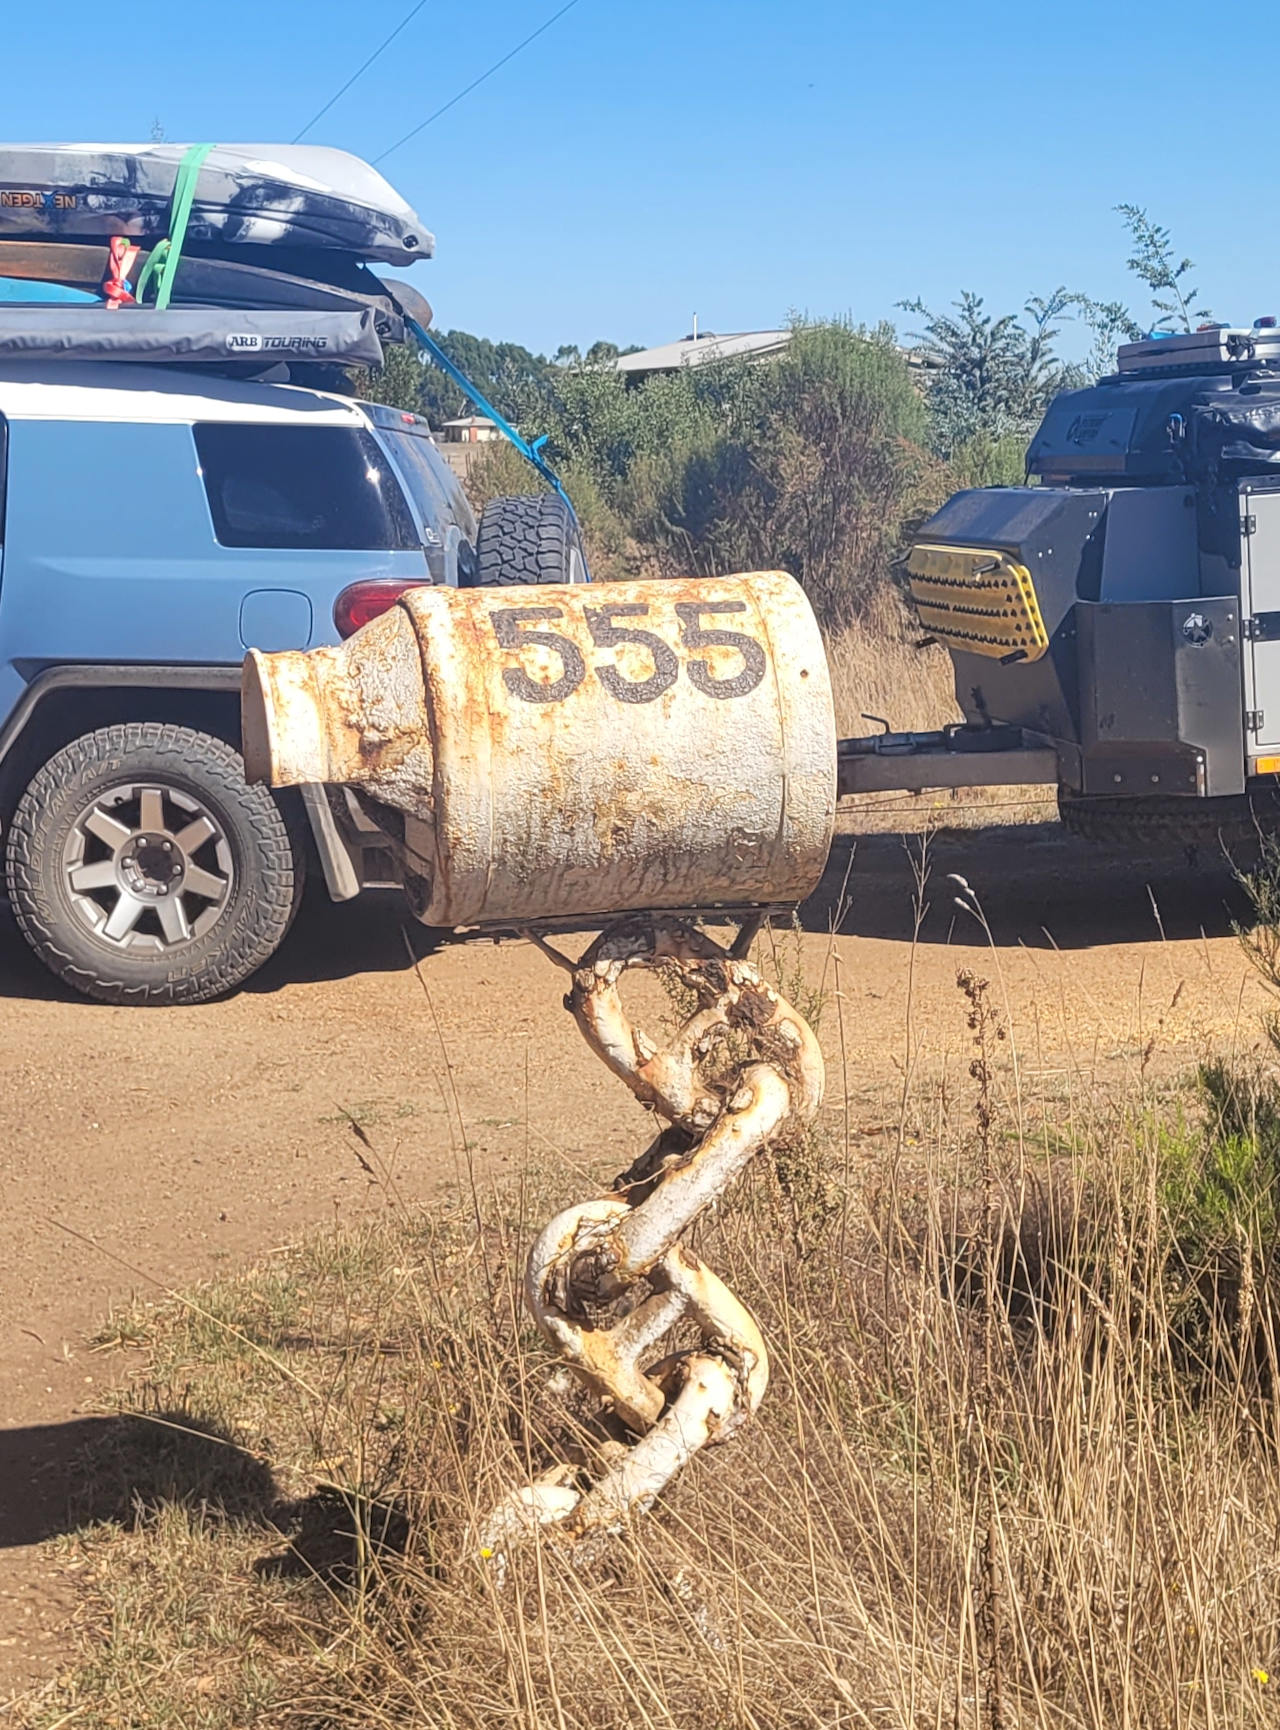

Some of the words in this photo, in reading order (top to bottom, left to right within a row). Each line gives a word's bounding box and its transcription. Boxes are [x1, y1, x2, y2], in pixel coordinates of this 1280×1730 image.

[1, 192, 77, 209] NEXTGEN
[230, 336, 258, 347] ARB
[263, 336, 328, 348] TOURING
[489, 600, 767, 704] 555
